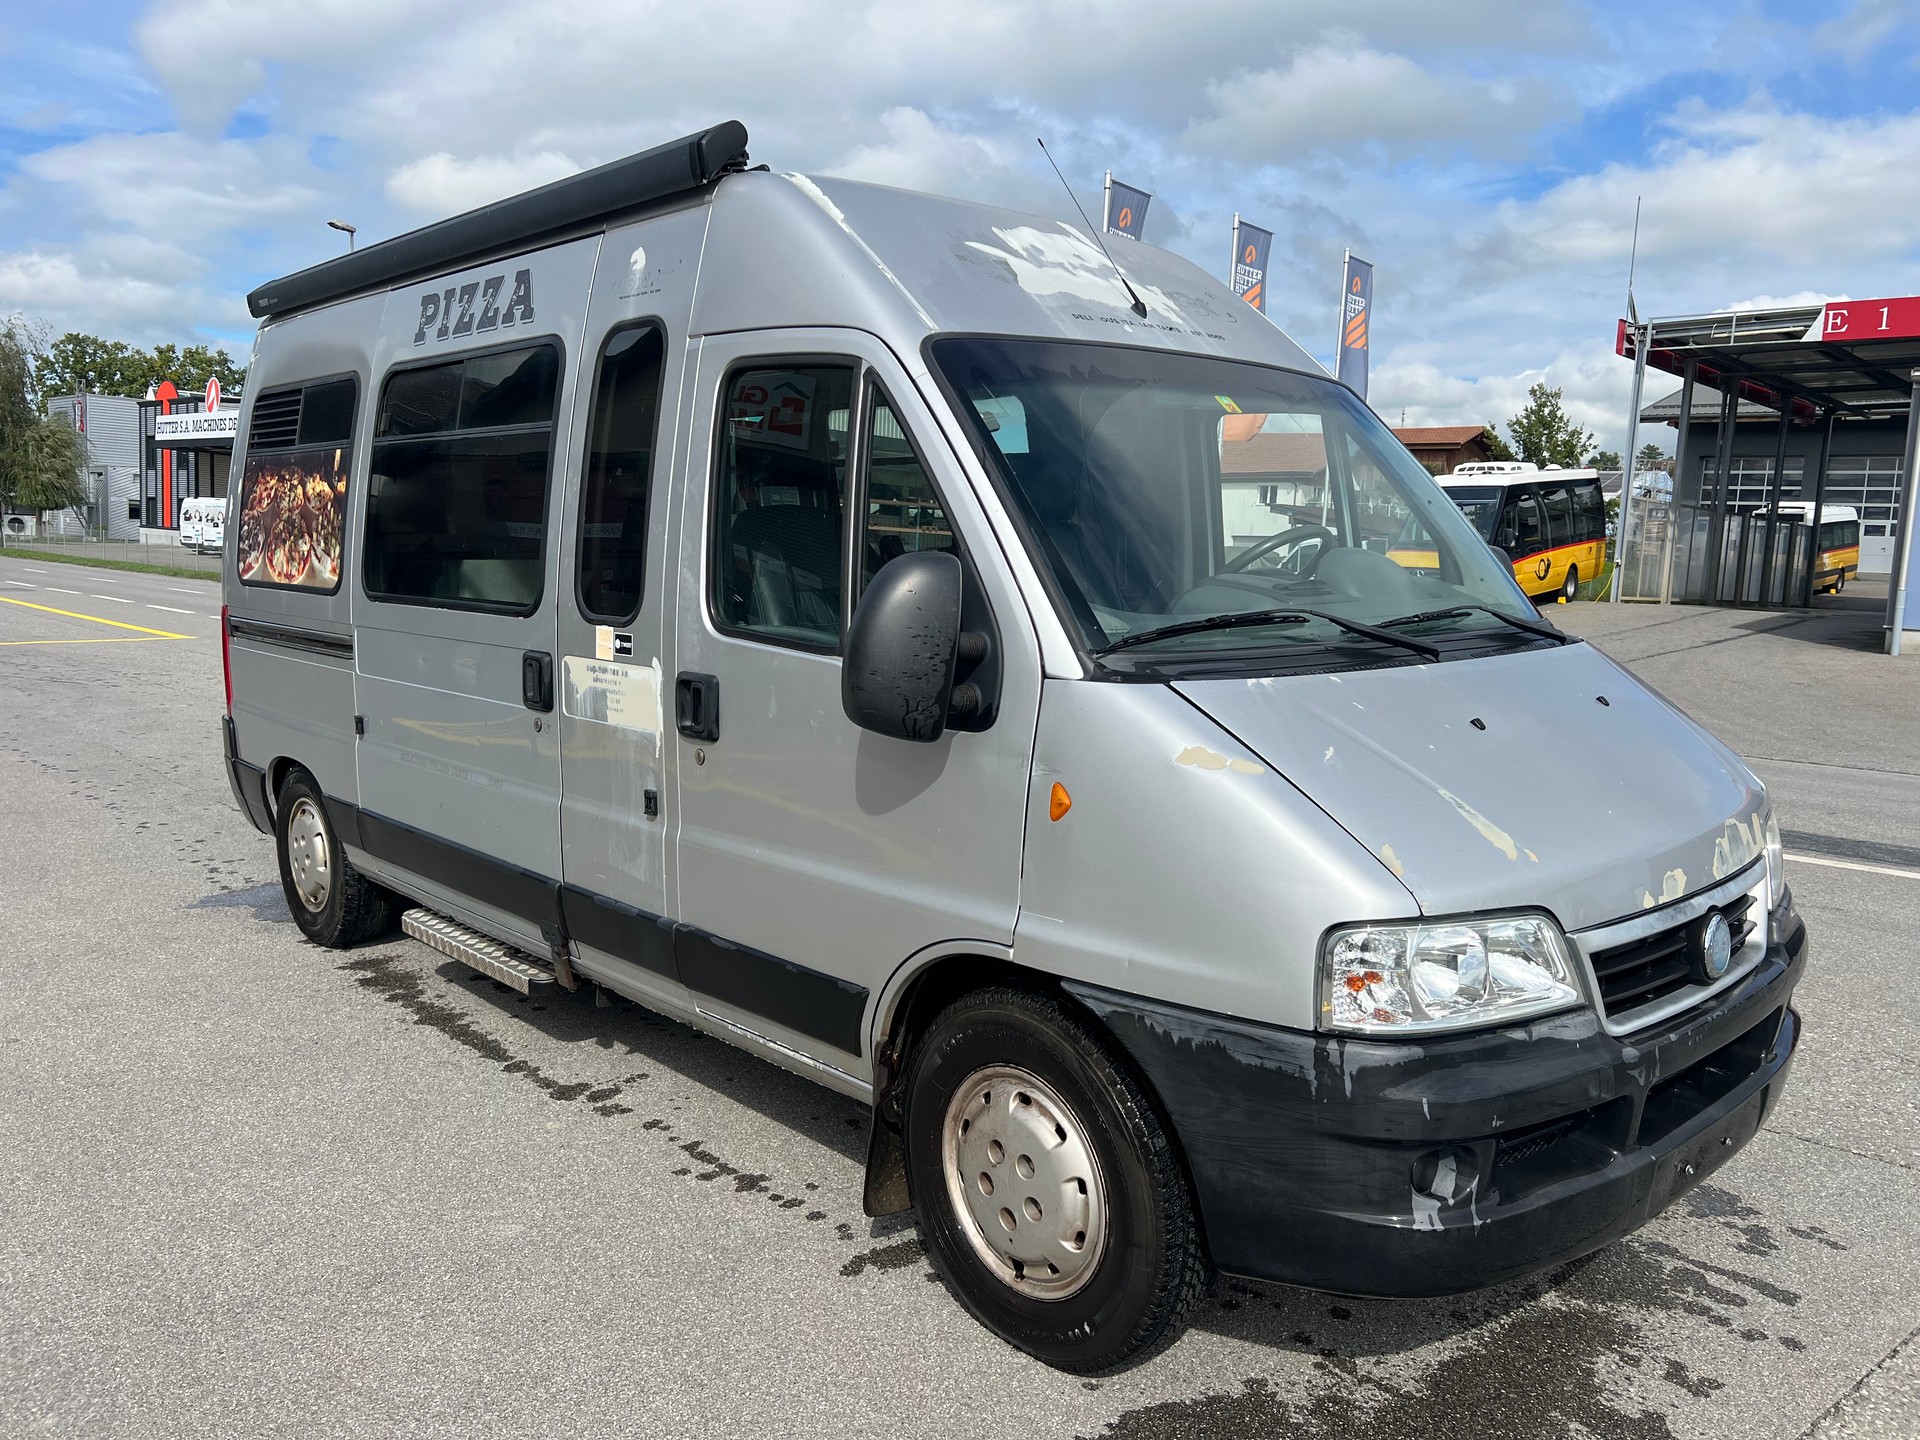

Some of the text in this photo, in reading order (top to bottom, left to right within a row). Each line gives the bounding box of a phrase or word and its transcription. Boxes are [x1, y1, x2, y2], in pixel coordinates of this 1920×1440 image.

[1236, 263, 1263, 280] HUTTER
[413, 268, 535, 347] PIZZA
[1823, 306, 1891, 334] E 1
[156, 421, 179, 434] HUTTER
[191, 418, 227, 433] MACHINES
